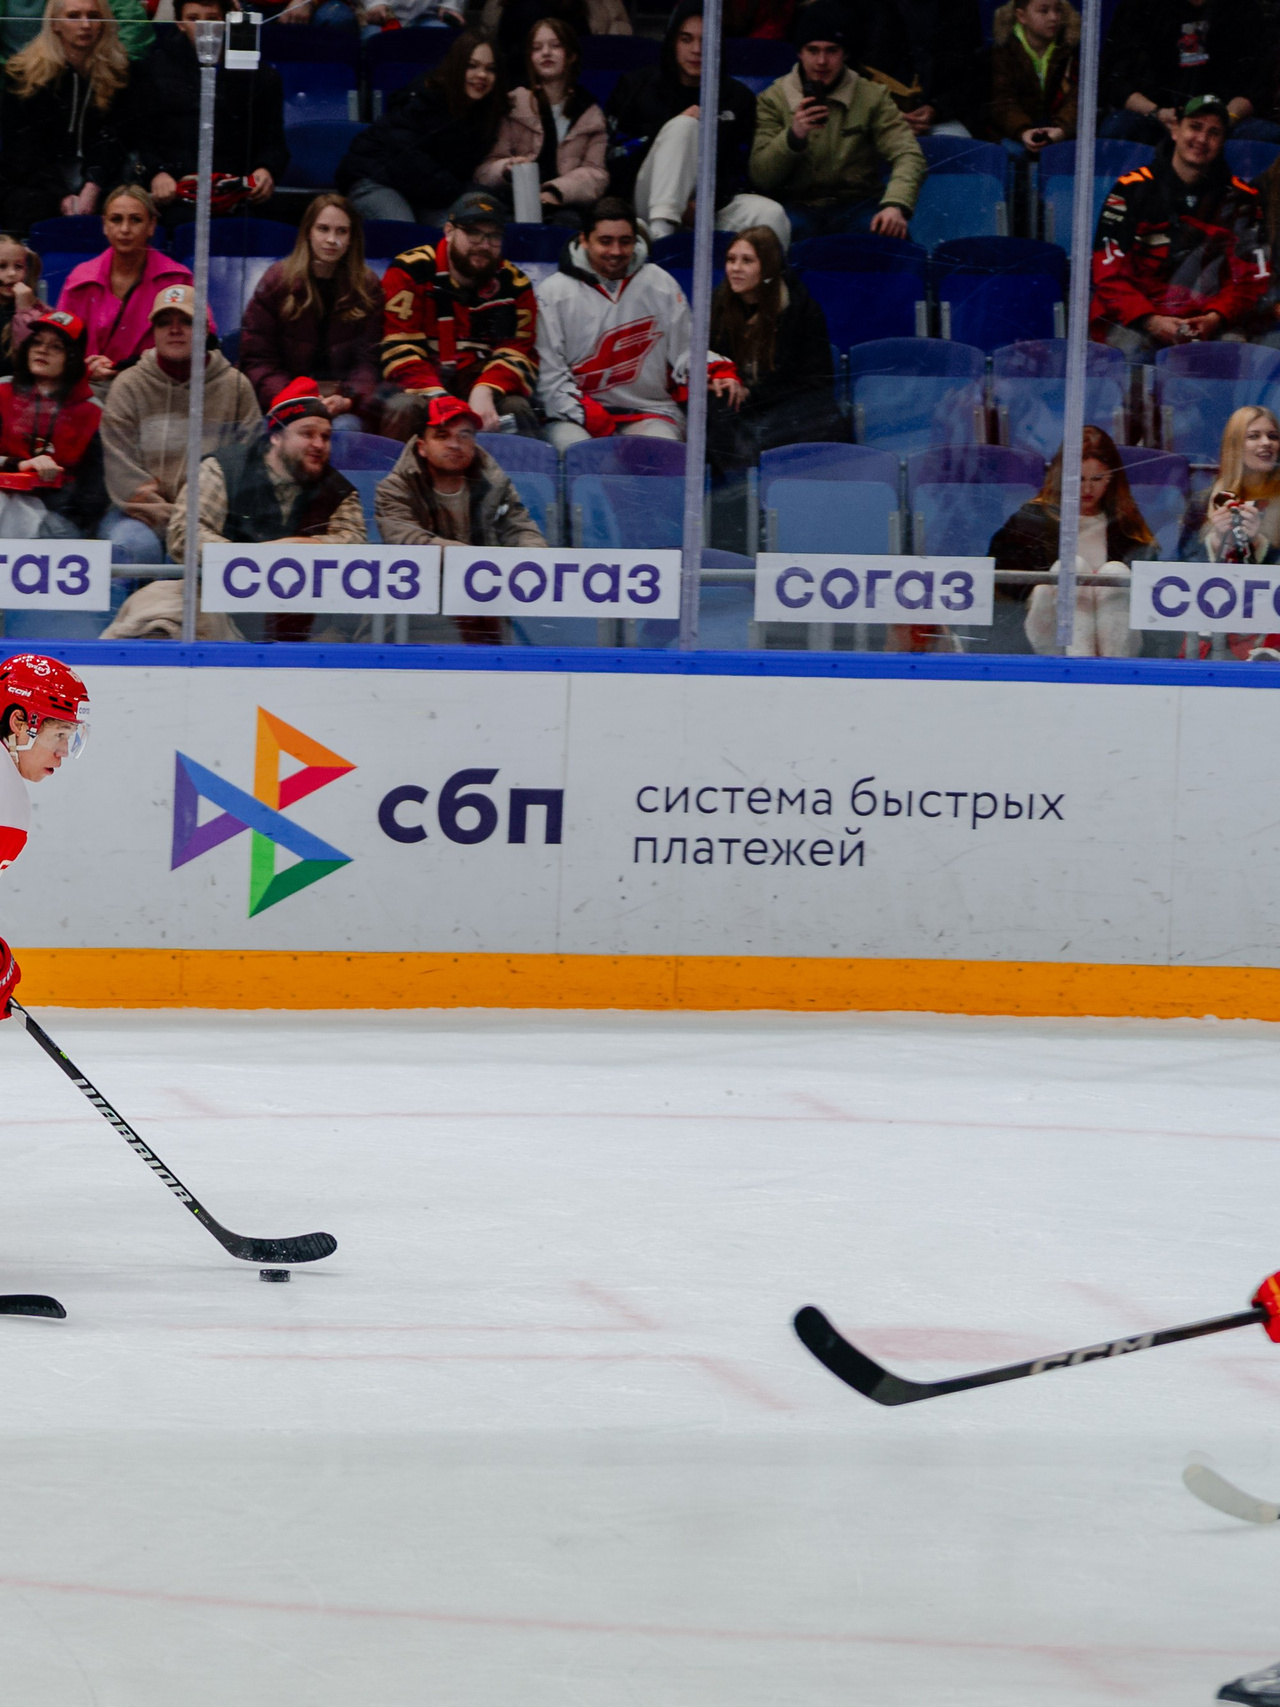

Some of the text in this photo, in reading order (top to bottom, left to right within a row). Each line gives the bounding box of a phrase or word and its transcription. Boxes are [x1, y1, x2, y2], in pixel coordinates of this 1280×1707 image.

[222, 556, 421, 600] согаз
[463, 560, 661, 604] согаз
[775, 566, 975, 611] согаз
[1151, 575, 1280, 619] сог
[377, 768, 565, 846] сбп
[636, 776, 1067, 830] система быстрых
[632, 827, 867, 868] платежей
[72, 1078, 193, 1203] WARRIOR
